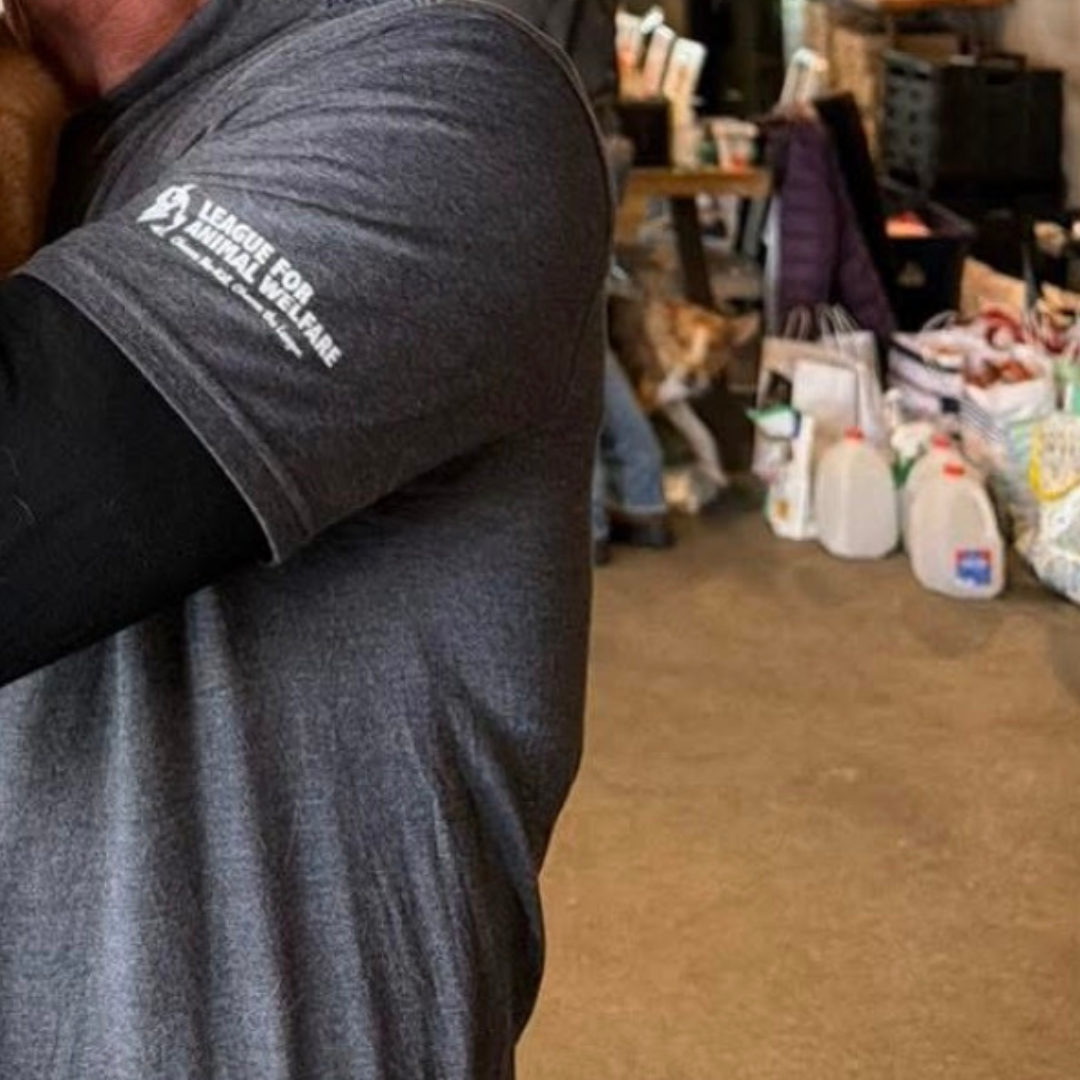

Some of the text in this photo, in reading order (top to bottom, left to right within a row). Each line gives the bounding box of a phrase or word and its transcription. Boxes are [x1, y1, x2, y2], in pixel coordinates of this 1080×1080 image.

[184, 221, 262, 284] ANIMAL
[258, 275, 342, 368] WELFARE
[198, 199, 275, 264] LEAGUE
[270, 257, 315, 306] FOR
